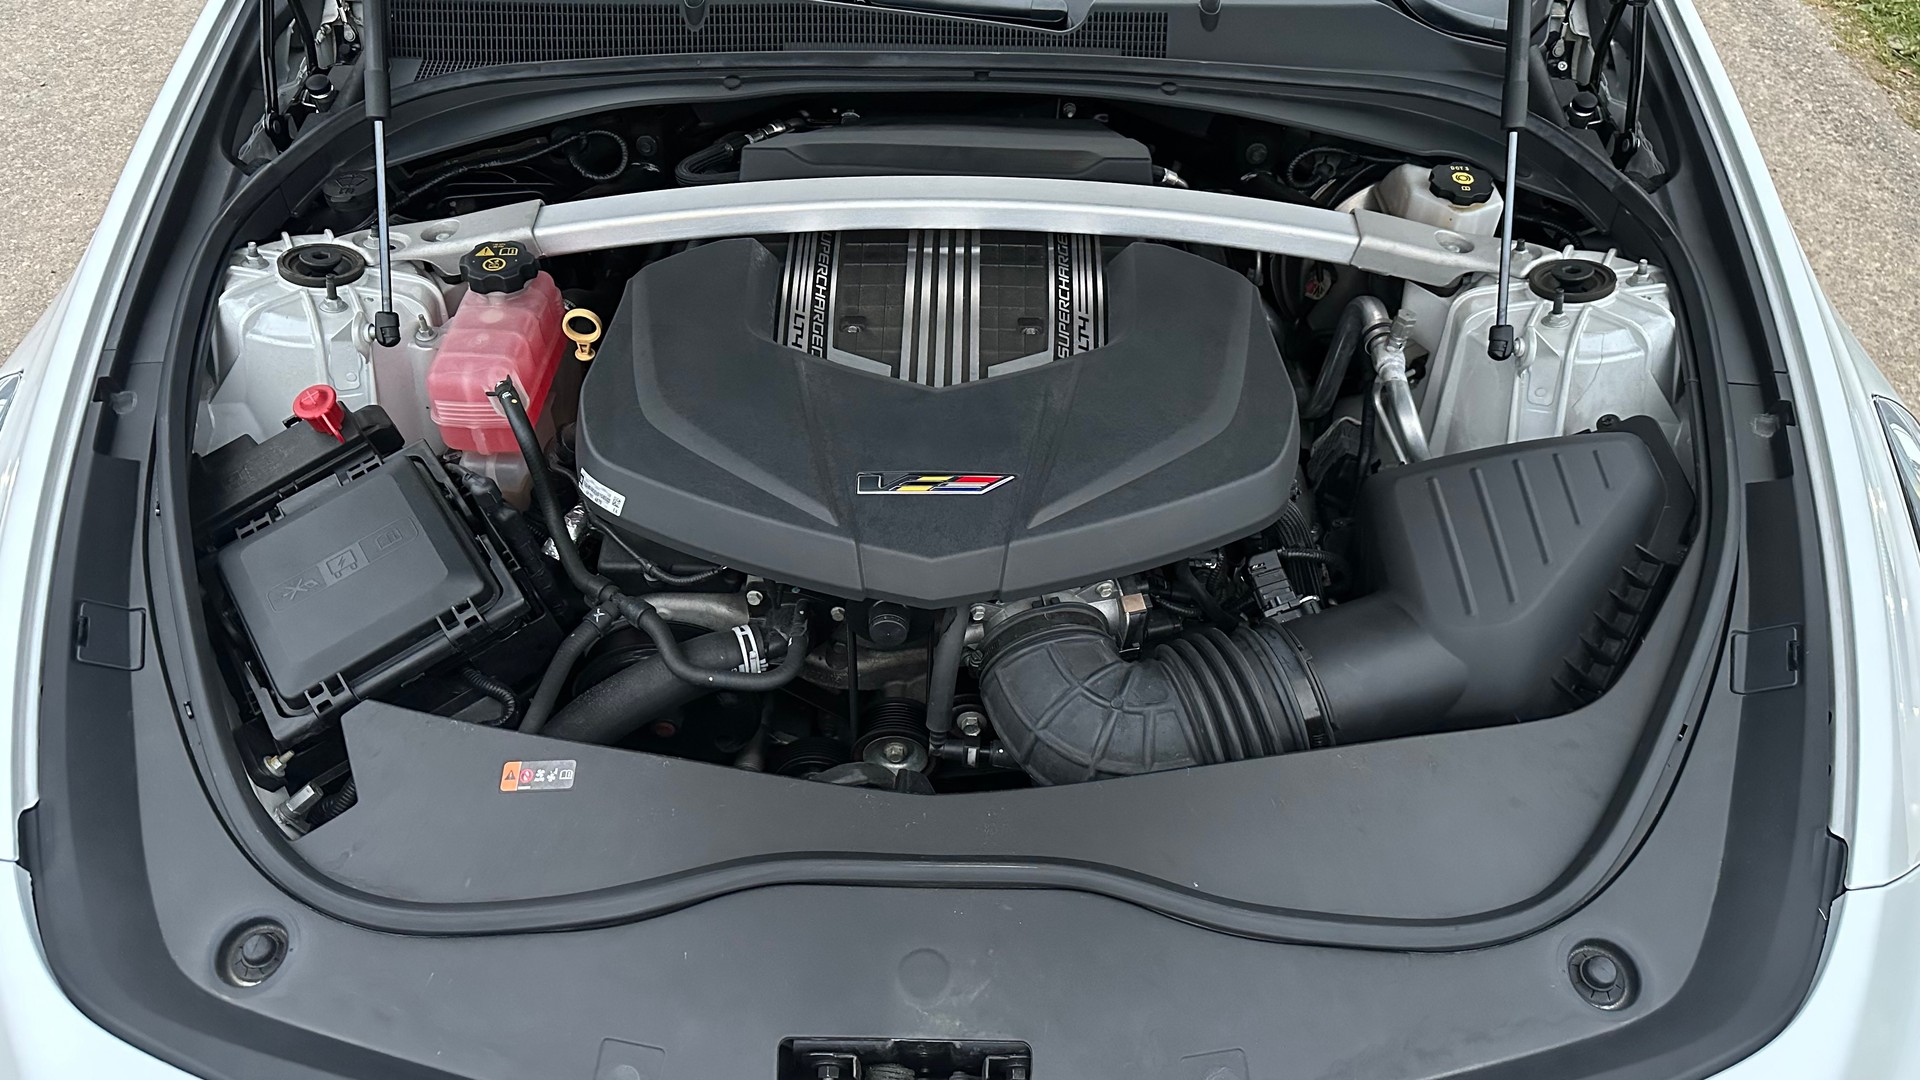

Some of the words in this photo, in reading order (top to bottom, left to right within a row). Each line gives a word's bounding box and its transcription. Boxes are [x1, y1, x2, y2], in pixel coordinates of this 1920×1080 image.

[791, 313, 805, 349] LT4
[811, 231, 832, 358] UPERCHARGED
[1057, 232, 1070, 359] SUPERCHARGE
[1078, 315, 1089, 351] LT4
